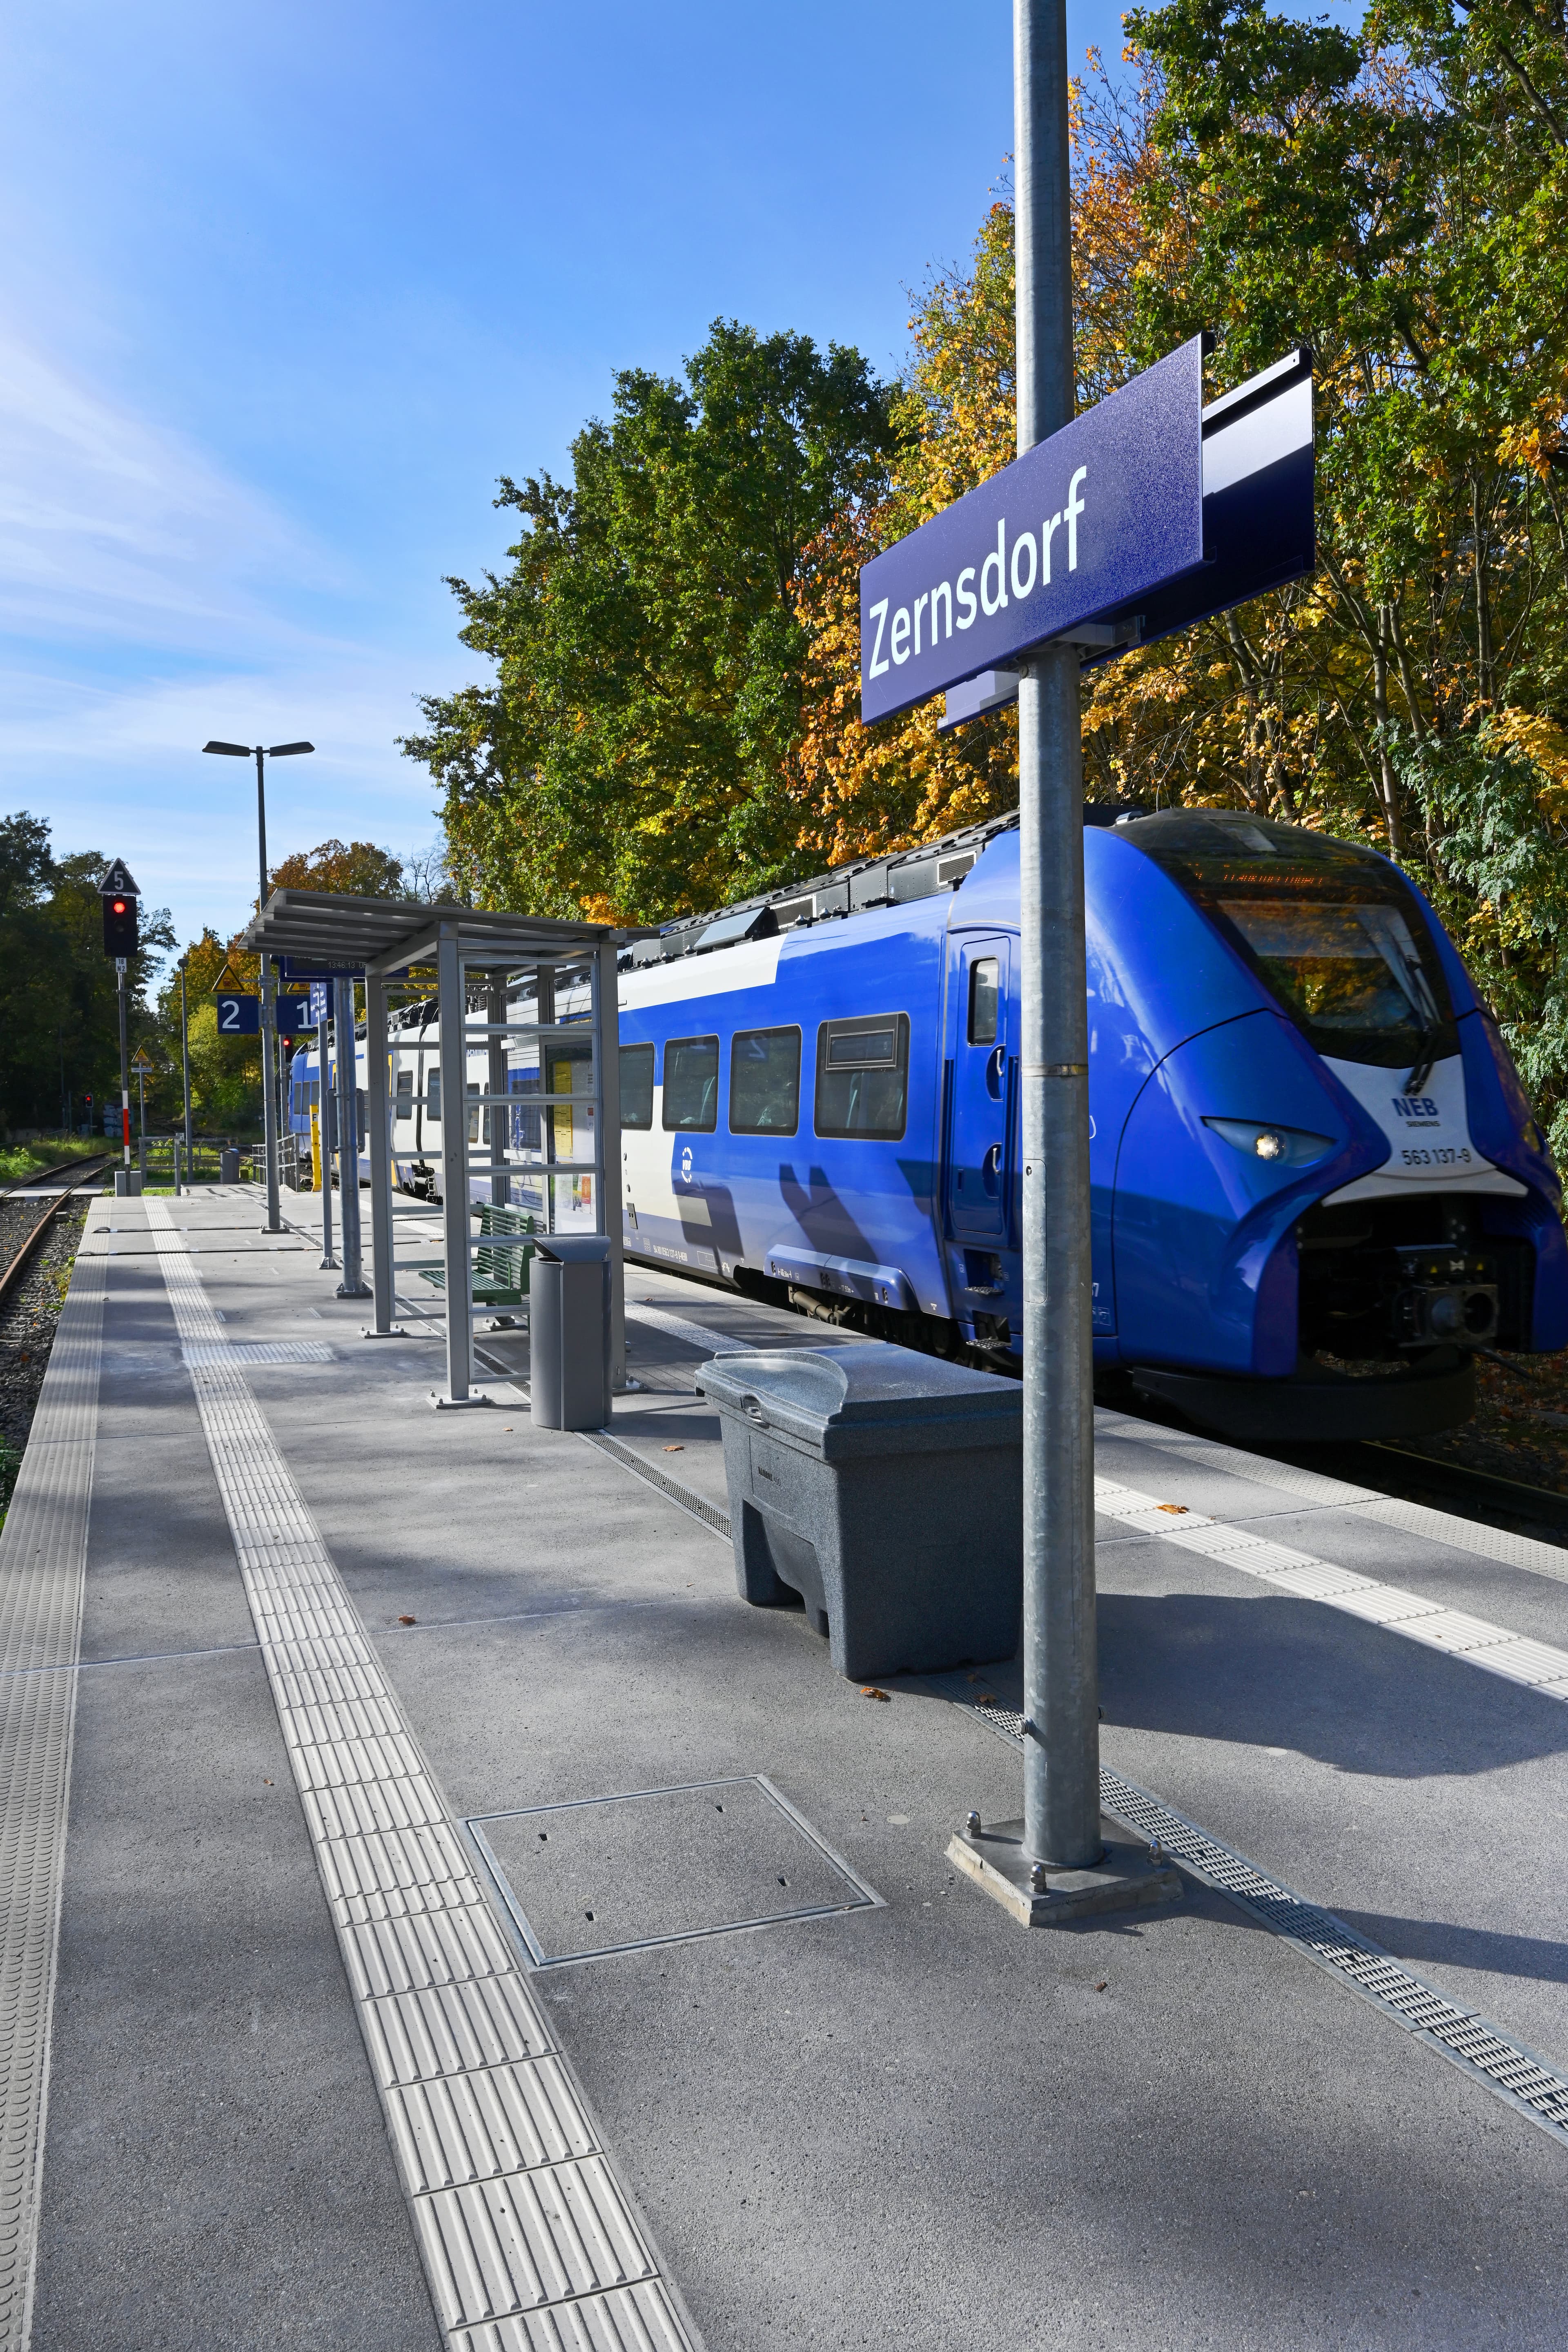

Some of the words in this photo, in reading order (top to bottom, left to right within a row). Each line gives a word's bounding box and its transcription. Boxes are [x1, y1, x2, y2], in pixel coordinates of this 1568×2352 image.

[868, 465, 1087, 680] Zernsdorf
[114, 871, 124, 890] 5
[221, 1000, 240, 1029] 2
[296, 1001, 313, 1029] 1
[1391, 1098, 1439, 1116] NEB
[682, 1159, 691, 1171] VBB
[1401, 1149, 1431, 1165] 563
[1431, 1148, 1472, 1164] 137-9
[653, 1245, 658, 1254] 94
[662, 1247, 670, 1257] 0563
[669, 1249, 678, 1259] 137-9
